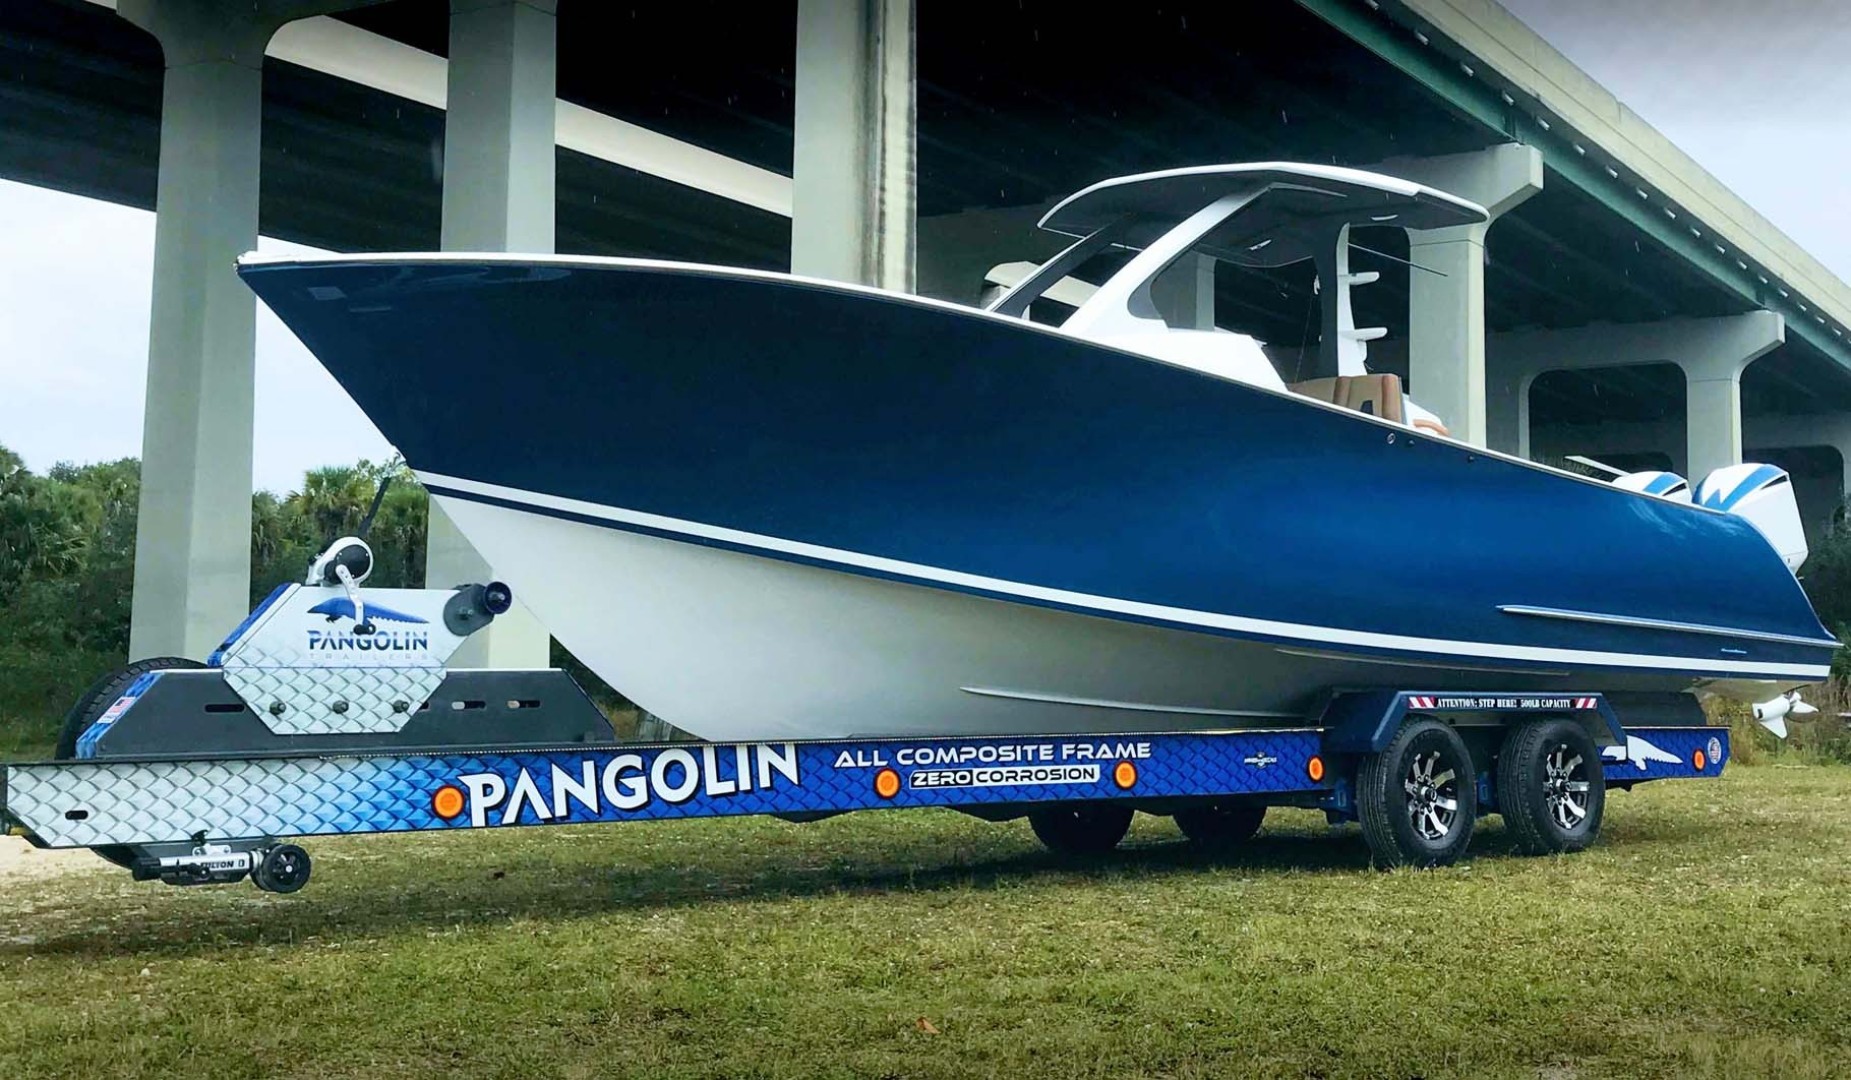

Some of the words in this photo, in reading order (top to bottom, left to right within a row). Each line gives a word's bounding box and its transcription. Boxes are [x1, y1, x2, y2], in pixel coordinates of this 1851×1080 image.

[306, 630, 428, 651] PANGOLIN
[1479, 699, 1495, 708] STEP
[1521, 699, 1540, 708] 500LB
[1541, 699, 1570, 708] CAPACITY
[834, 750, 888, 768] ALL
[897, 744, 1054, 765] COMPOSITE
[1062, 742, 1151, 760] FRAME
[457, 744, 799, 828] PANGOLIN
[913, 771, 971, 786] ZERO
[976, 767, 1095, 783] CORROSION
